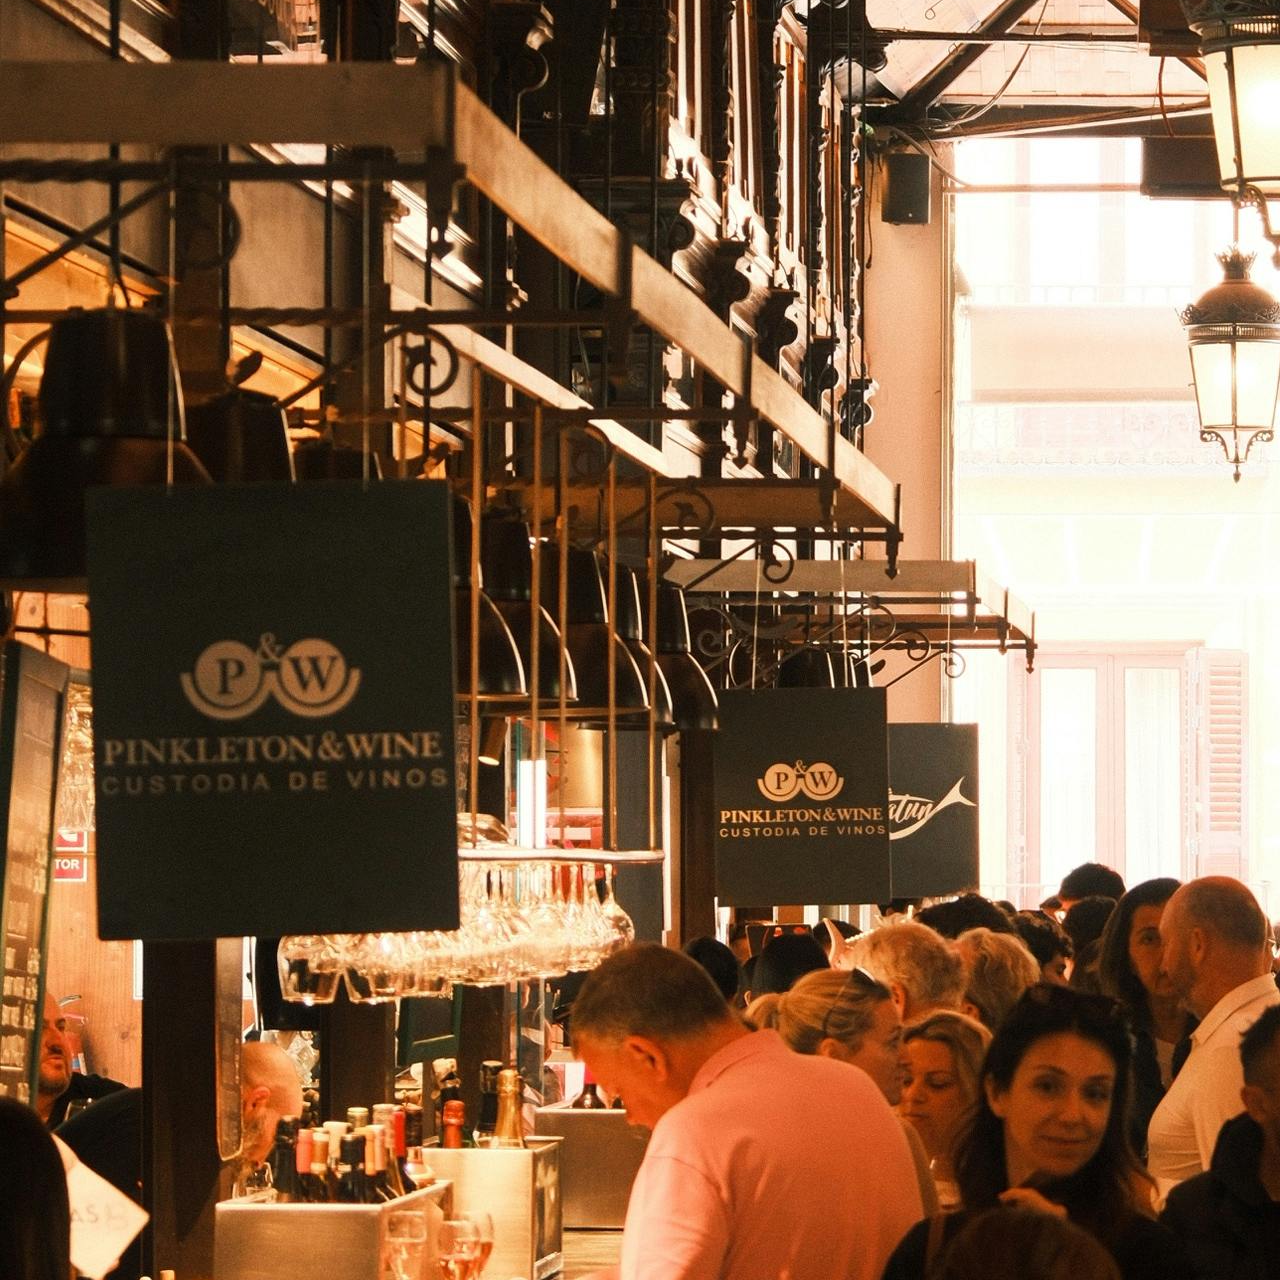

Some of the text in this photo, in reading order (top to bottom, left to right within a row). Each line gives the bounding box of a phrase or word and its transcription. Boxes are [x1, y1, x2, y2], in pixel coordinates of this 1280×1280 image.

[103, 730, 443, 767] PINKLETON&WINE
[102, 768, 449, 796] CUSTODIA DE VINOS
[719, 806, 883, 824] PINKLETON&WINE
[719, 825, 886, 838] CUSTODIA DE VINOS
[54, 858, 80, 870] TOR
